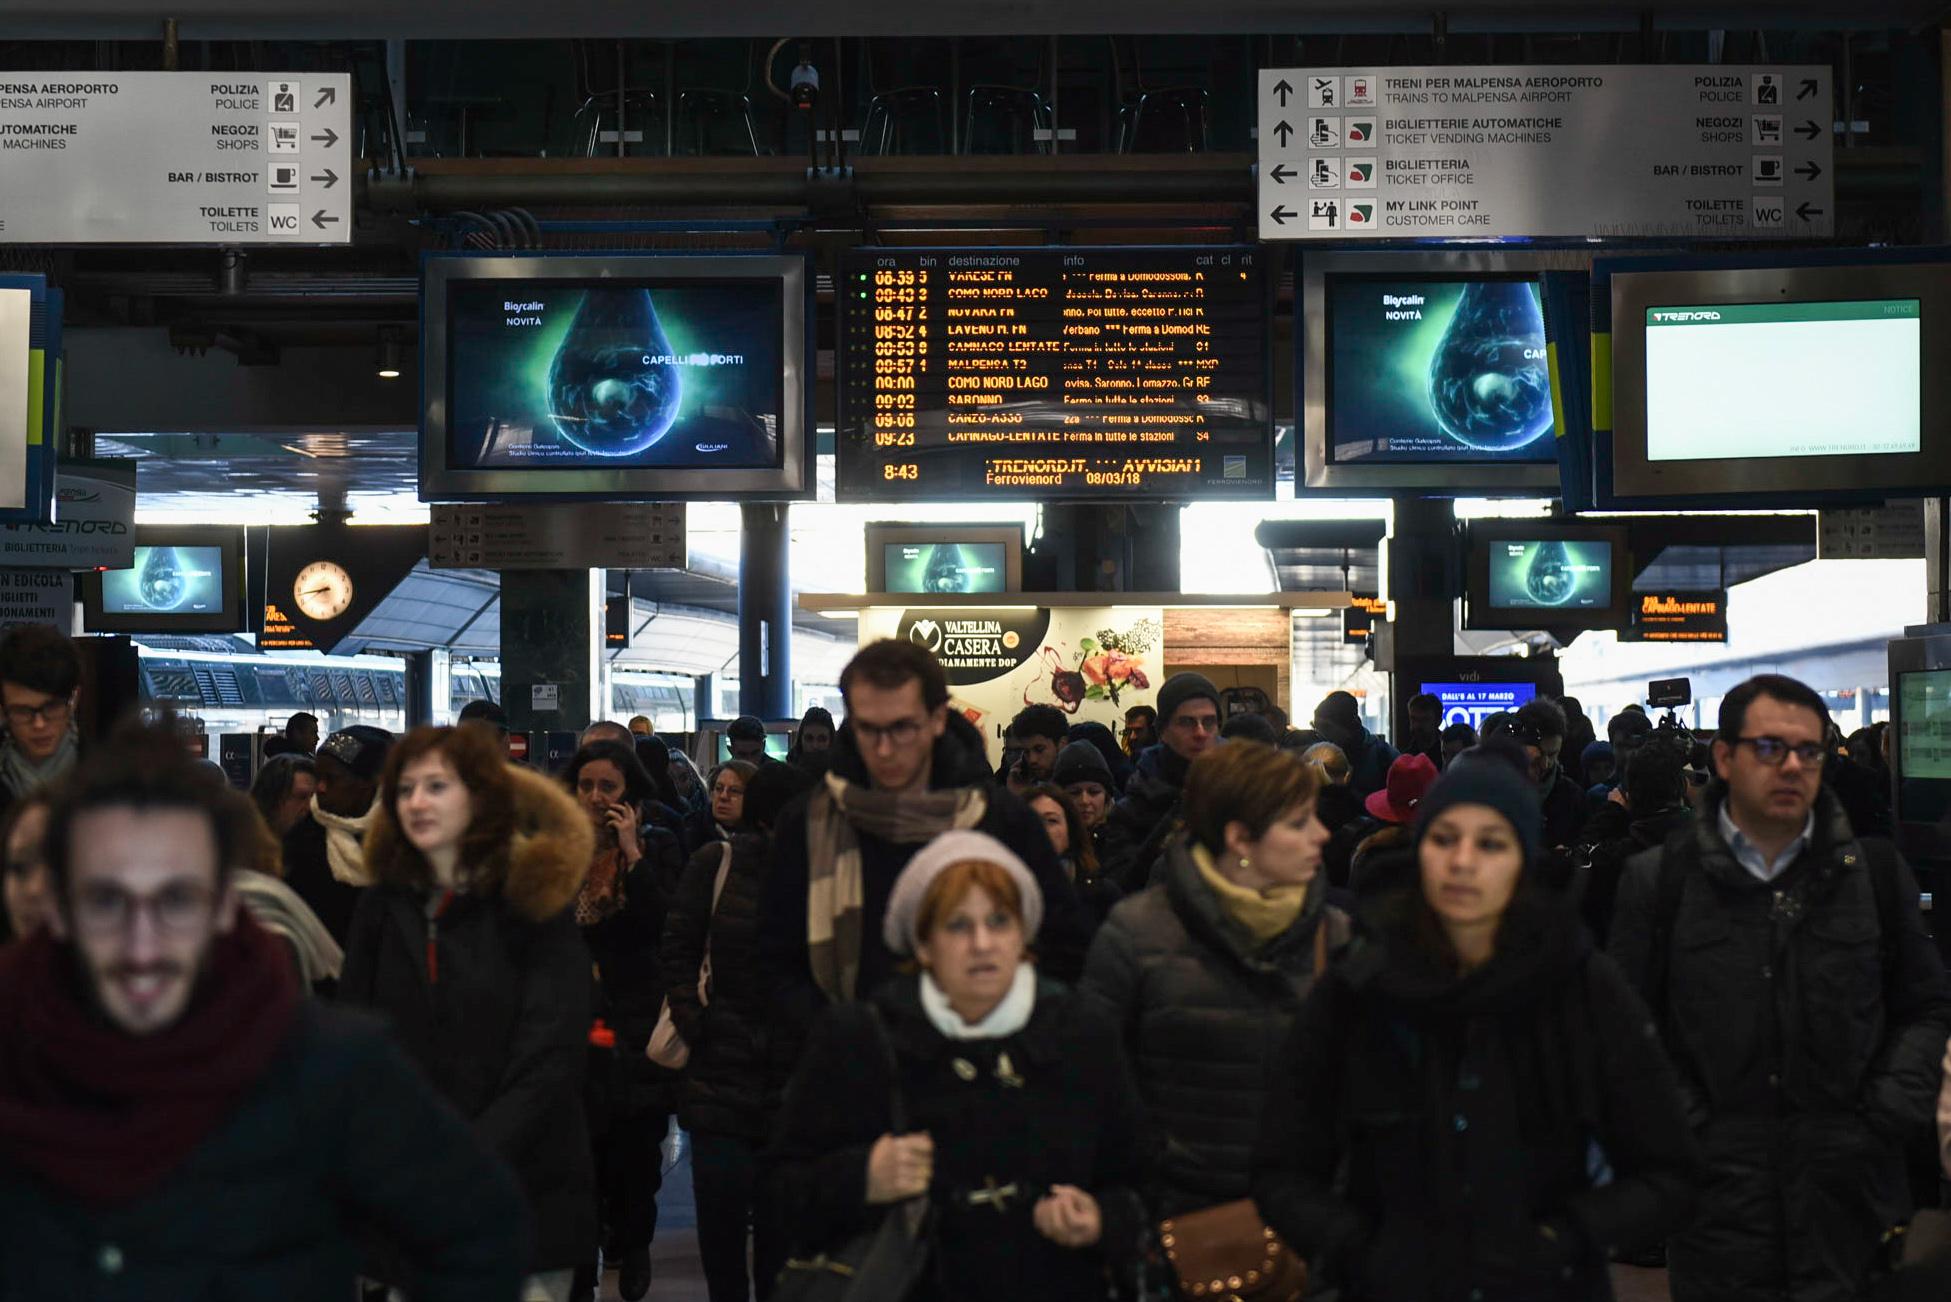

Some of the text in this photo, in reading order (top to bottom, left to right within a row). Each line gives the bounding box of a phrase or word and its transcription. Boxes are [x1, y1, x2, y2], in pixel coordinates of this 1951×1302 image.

[1386, 77, 1603, 88] TRENI PER MALPENSA AEROPORTO
[1695, 77, 1742, 87] POLIZIA
[41, 84, 118, 94] AEROPORTO
[211, 84, 259, 95] POLIZIA
[1386, 92, 1572, 103] TRAINS TO MALPENSA AIRPORT
[1700, 91, 1742, 102] POLICE
[36, 98, 87, 109] AIRPORT
[215, 99, 259, 109] POLICE
[1386, 118, 1562, 129] BIGLIETTERIE AUTOMATICHE
[1696, 117, 1743, 128] NEGOZI
[212, 125, 259, 135] NEGOZI
[1386, 132, 1551, 144] TICKET VENDING MACHINES
[1702, 131, 1743, 142] SHOPS
[4, 139, 66, 149] MACHINES
[217, 139, 259, 150] SHOPS
[1386, 160, 1469, 170] BIGLIETTERIA
[1654, 165, 1679, 176] BAR
[1691, 165, 1744, 176] BISTROT
[168, 172, 193, 182] BAR
[206, 172, 259, 183] BISTROT
[1386, 174, 1473, 185] TICKET OFFICE
[1387, 201, 1478, 211] MY LINK POINT
[1685, 200, 1743, 210] TOILETTE
[200, 207, 259, 217] TOILETTE
[1756, 208, 1782, 221] WC
[270, 216, 297, 229] WC
[1387, 215, 1490, 226] CUSTOMER CARE
[1696, 215, 1744, 225] TOILETS
[210, 222, 259, 231] TOILETS
[877, 257, 896, 266] ora
[920, 256, 937, 266] bin
[949, 255, 1020, 266] destinazione
[1064, 255, 1084, 266] info
[506, 315, 542, 326] NOVITÀ
[1386, 310, 1422, 320] NOVITÀ
[1662, 311, 1720, 321] TRENORD
[642, 355, 688, 364] CAPELLI
[948, 377, 981, 388] COMO
[983, 377, 1014, 388] NORD
[1017, 377, 1049, 388] LAGO
[948, 395, 1003, 404] SARONNO
[884, 464, 919, 480] 8:43
[986, 472, 1142, 485] Ferrovienord 08/03/18
[15, 574, 63, 587] EDICOLA
[945, 621, 1001, 633] VALTELLINA
[944, 638, 1002, 655] CASERA
[998, 658, 1018, 667] DOP
[1467, 692, 1477, 701] AL
[1478, 692, 1487, 701] 17
[1488, 692, 1514, 701] MARZO
